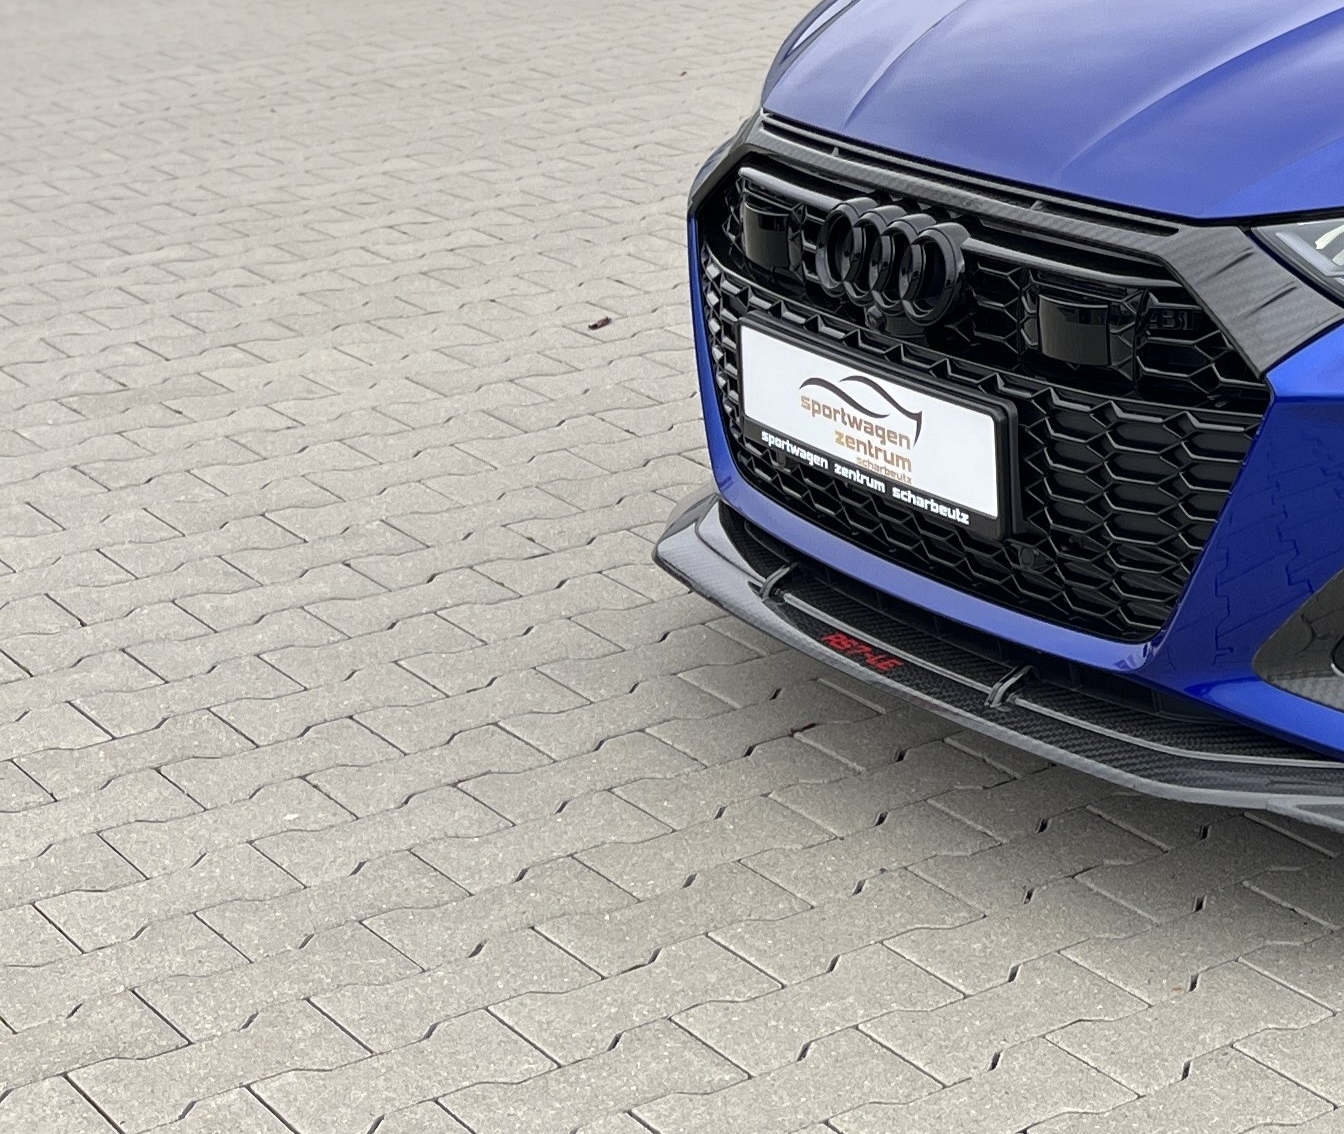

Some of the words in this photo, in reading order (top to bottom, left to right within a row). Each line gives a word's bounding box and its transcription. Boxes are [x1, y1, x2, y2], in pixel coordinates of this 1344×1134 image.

[801, 394, 911, 451] sportwagen
[834, 430, 912, 473] zentrum
[856, 456, 913, 485] scharbeutz
[761, 430, 829, 470] sportwagen
[834, 462, 886, 494] zentrum
[892, 485, 970, 526] scharbeutz
